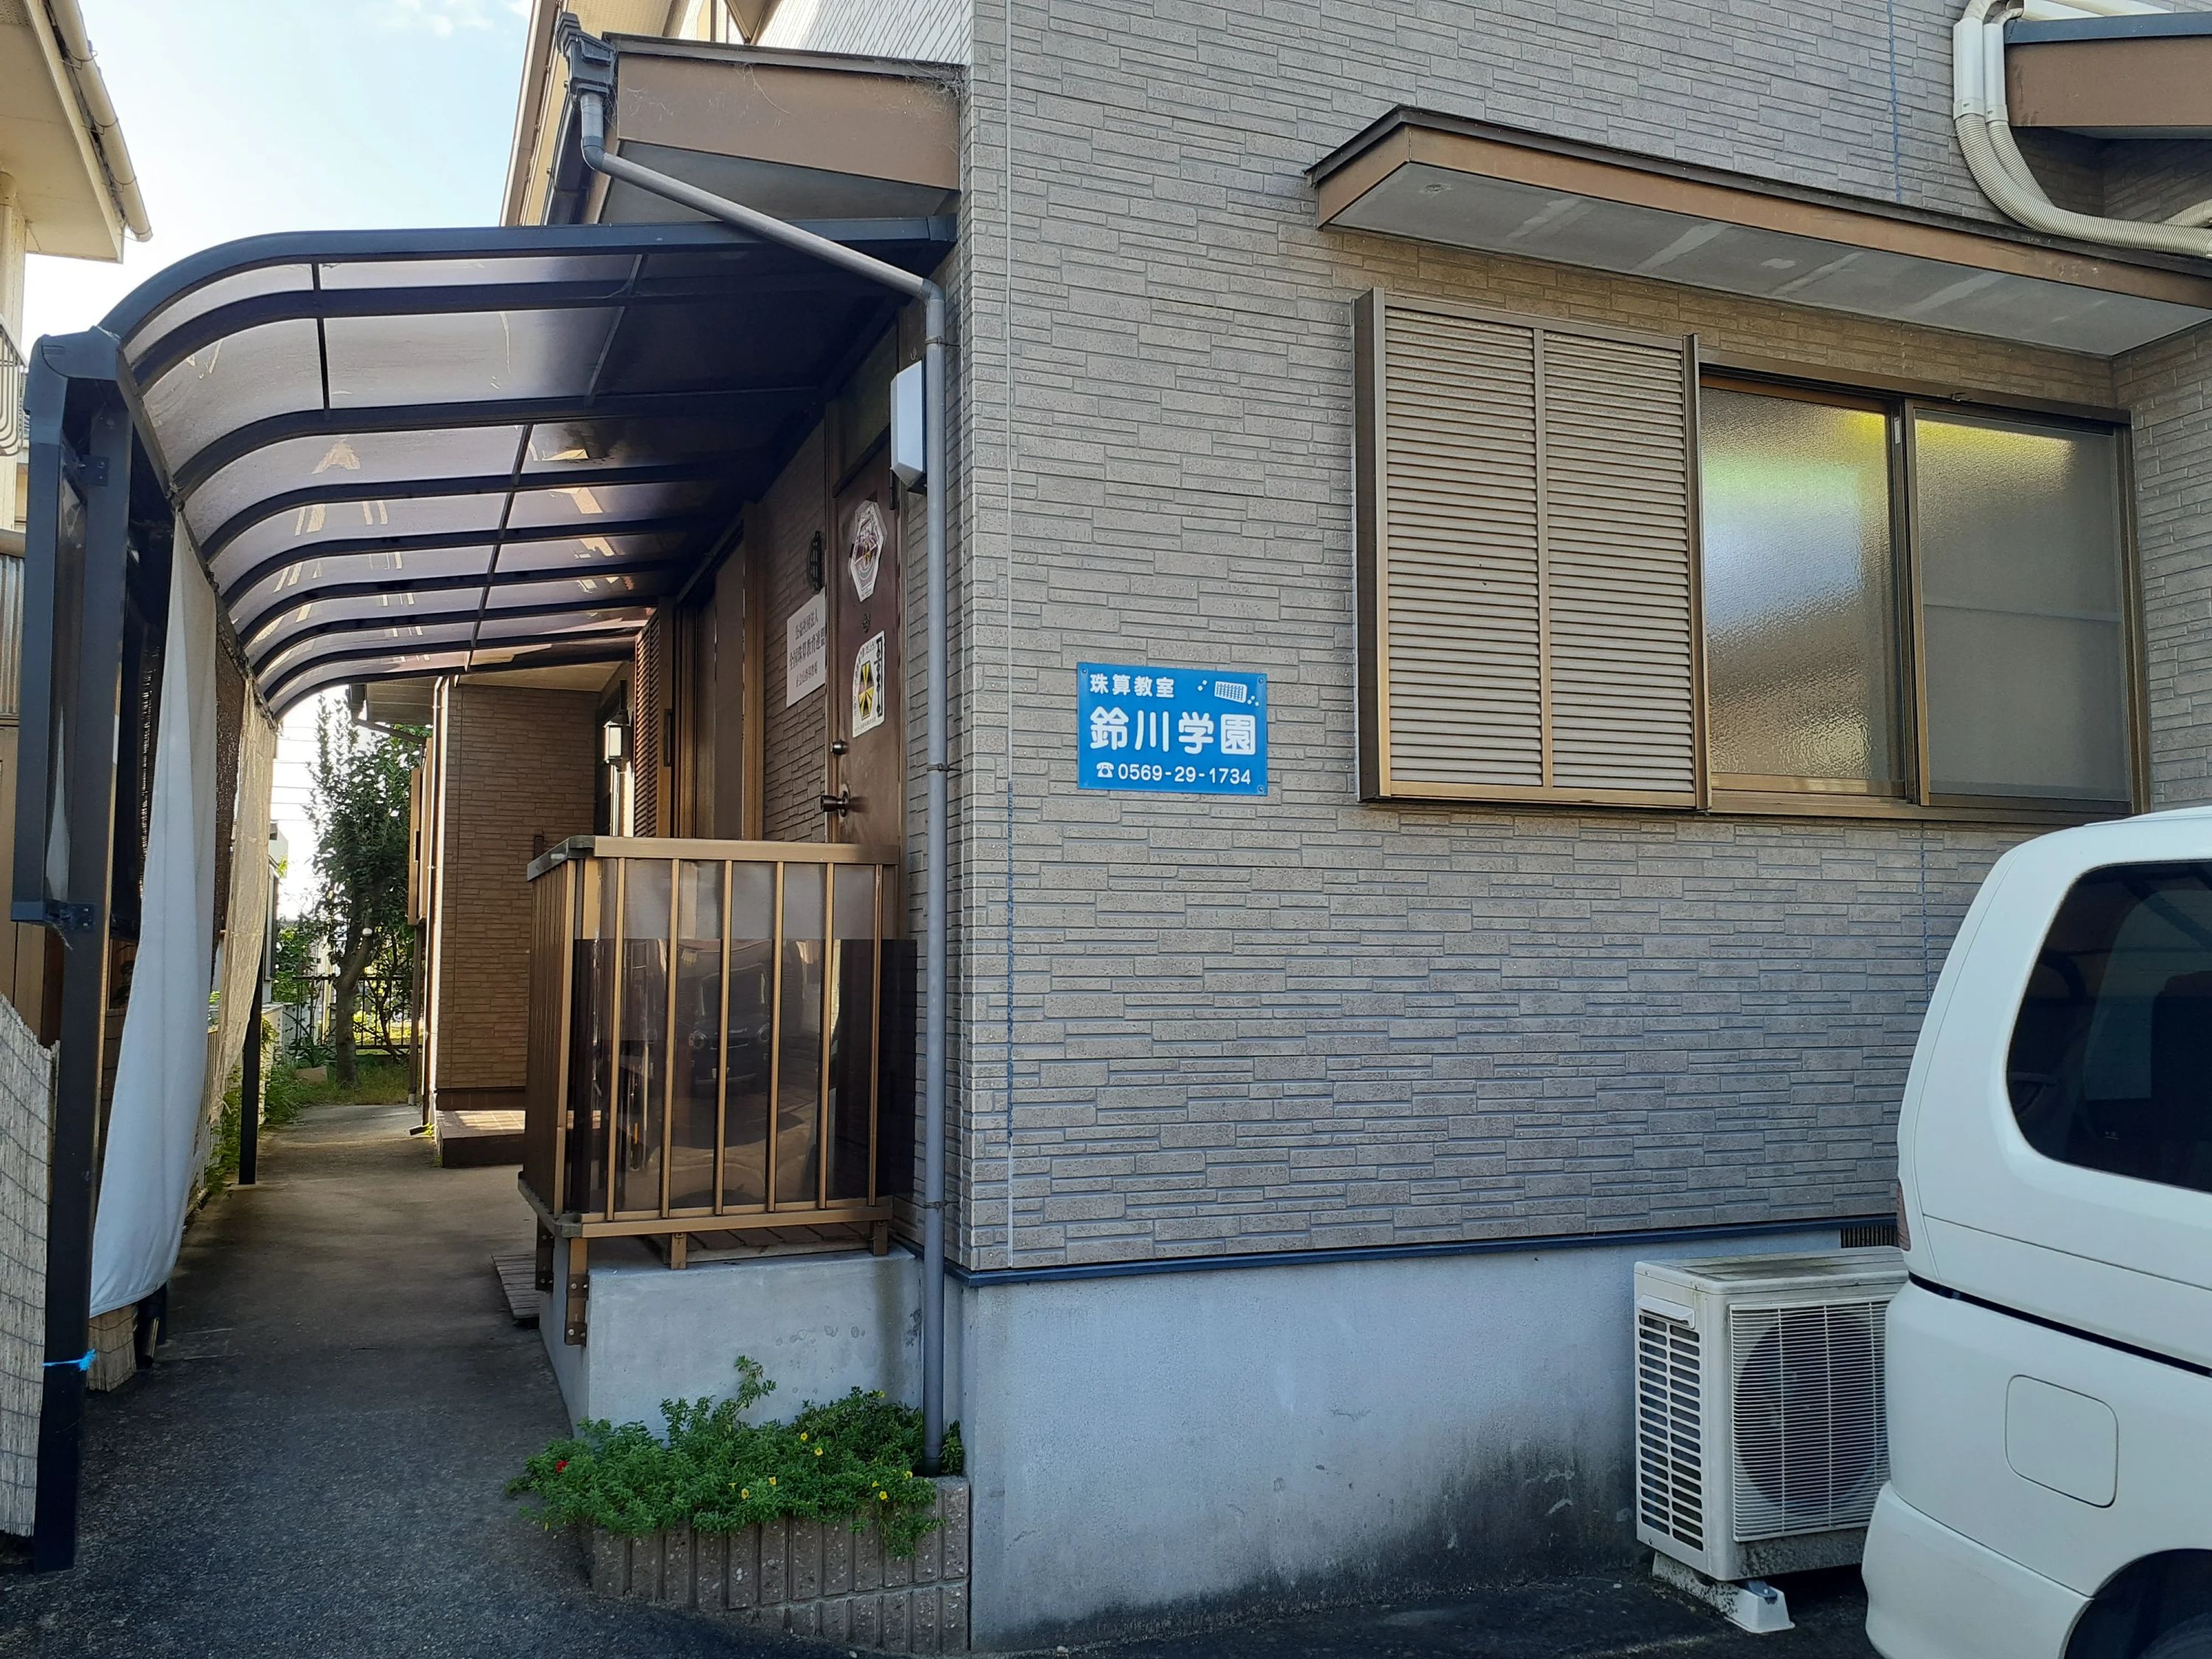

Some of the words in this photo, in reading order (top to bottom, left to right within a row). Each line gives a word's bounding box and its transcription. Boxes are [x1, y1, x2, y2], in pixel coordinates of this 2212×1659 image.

[1090, 673, 1175, 698] 珠算教室
[1090, 706, 1256, 755] 鈴川学園
[1118, 764, 1251, 785] 0569-29-1734
